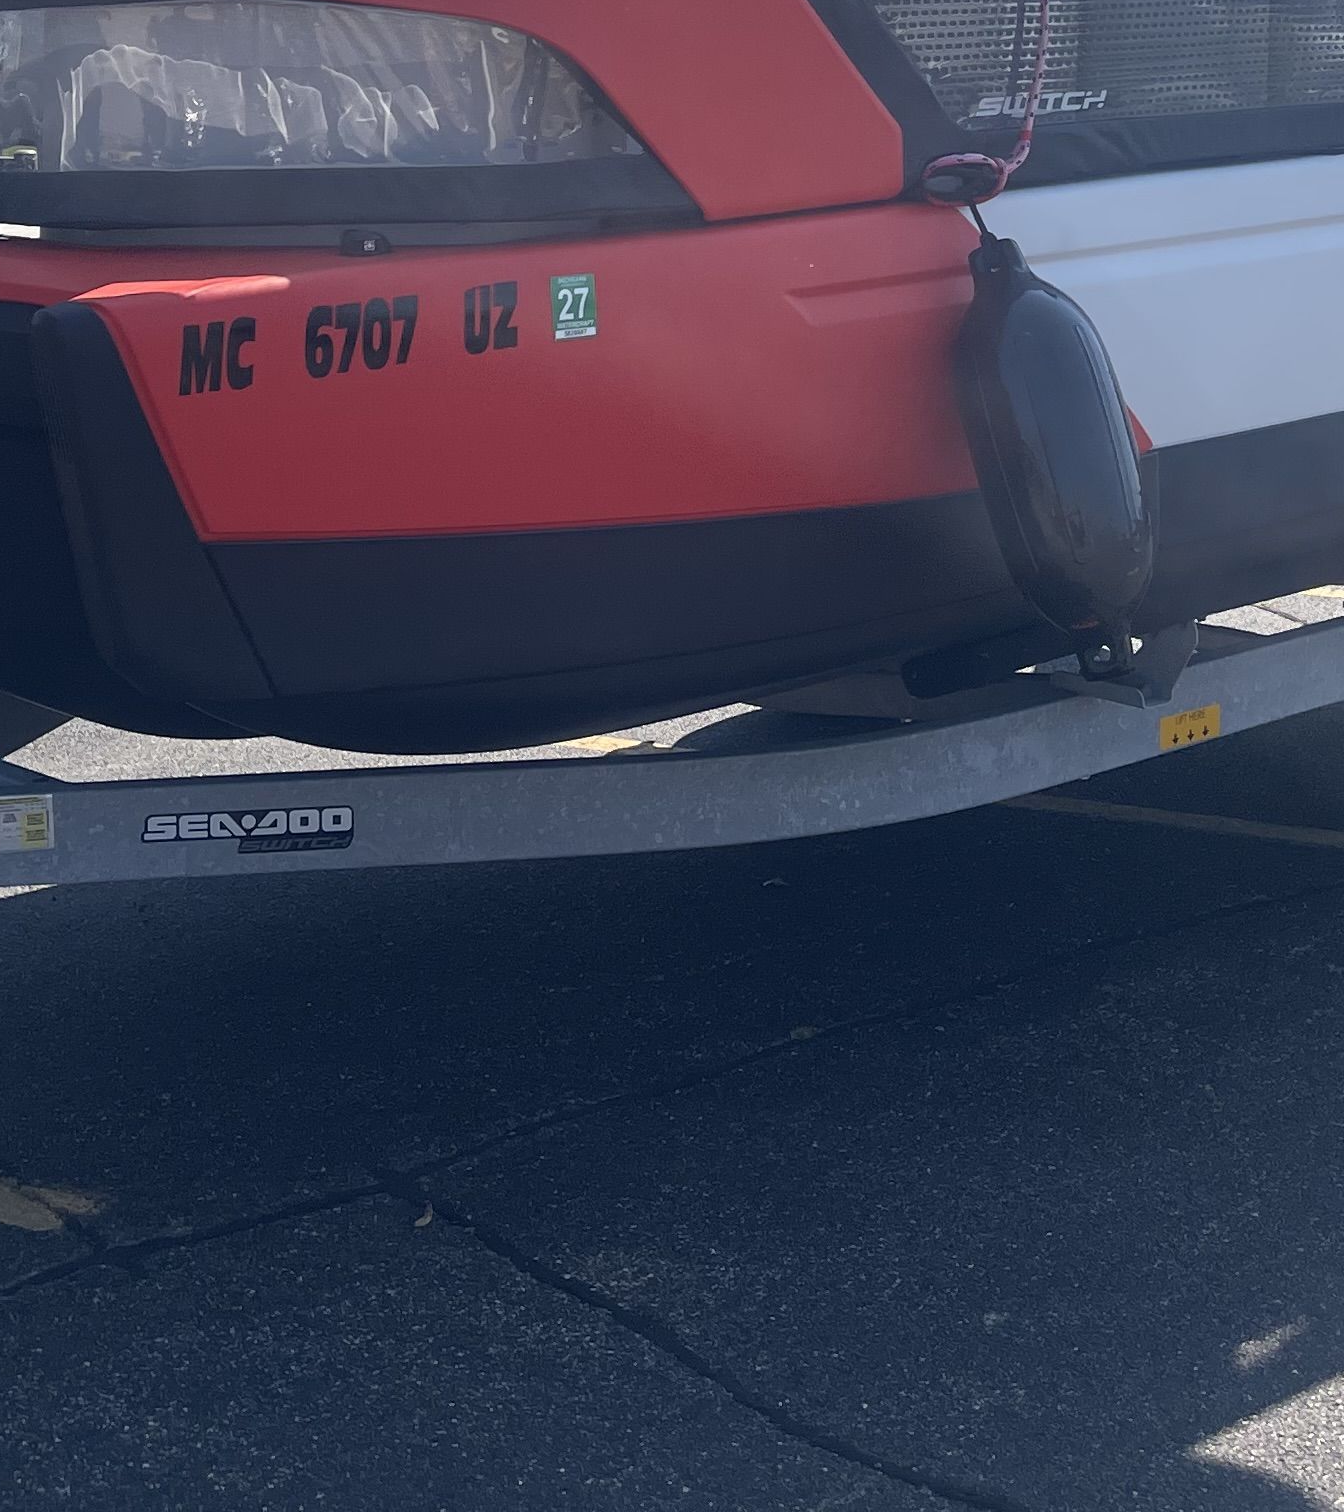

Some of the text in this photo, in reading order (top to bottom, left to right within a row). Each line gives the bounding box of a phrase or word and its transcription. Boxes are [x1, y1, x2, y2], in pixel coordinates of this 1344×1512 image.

[975, 90, 1108, 117] SWTCH
[557, 287, 589, 320] 27
[178, 281, 518, 396] MC 6707 UZ
